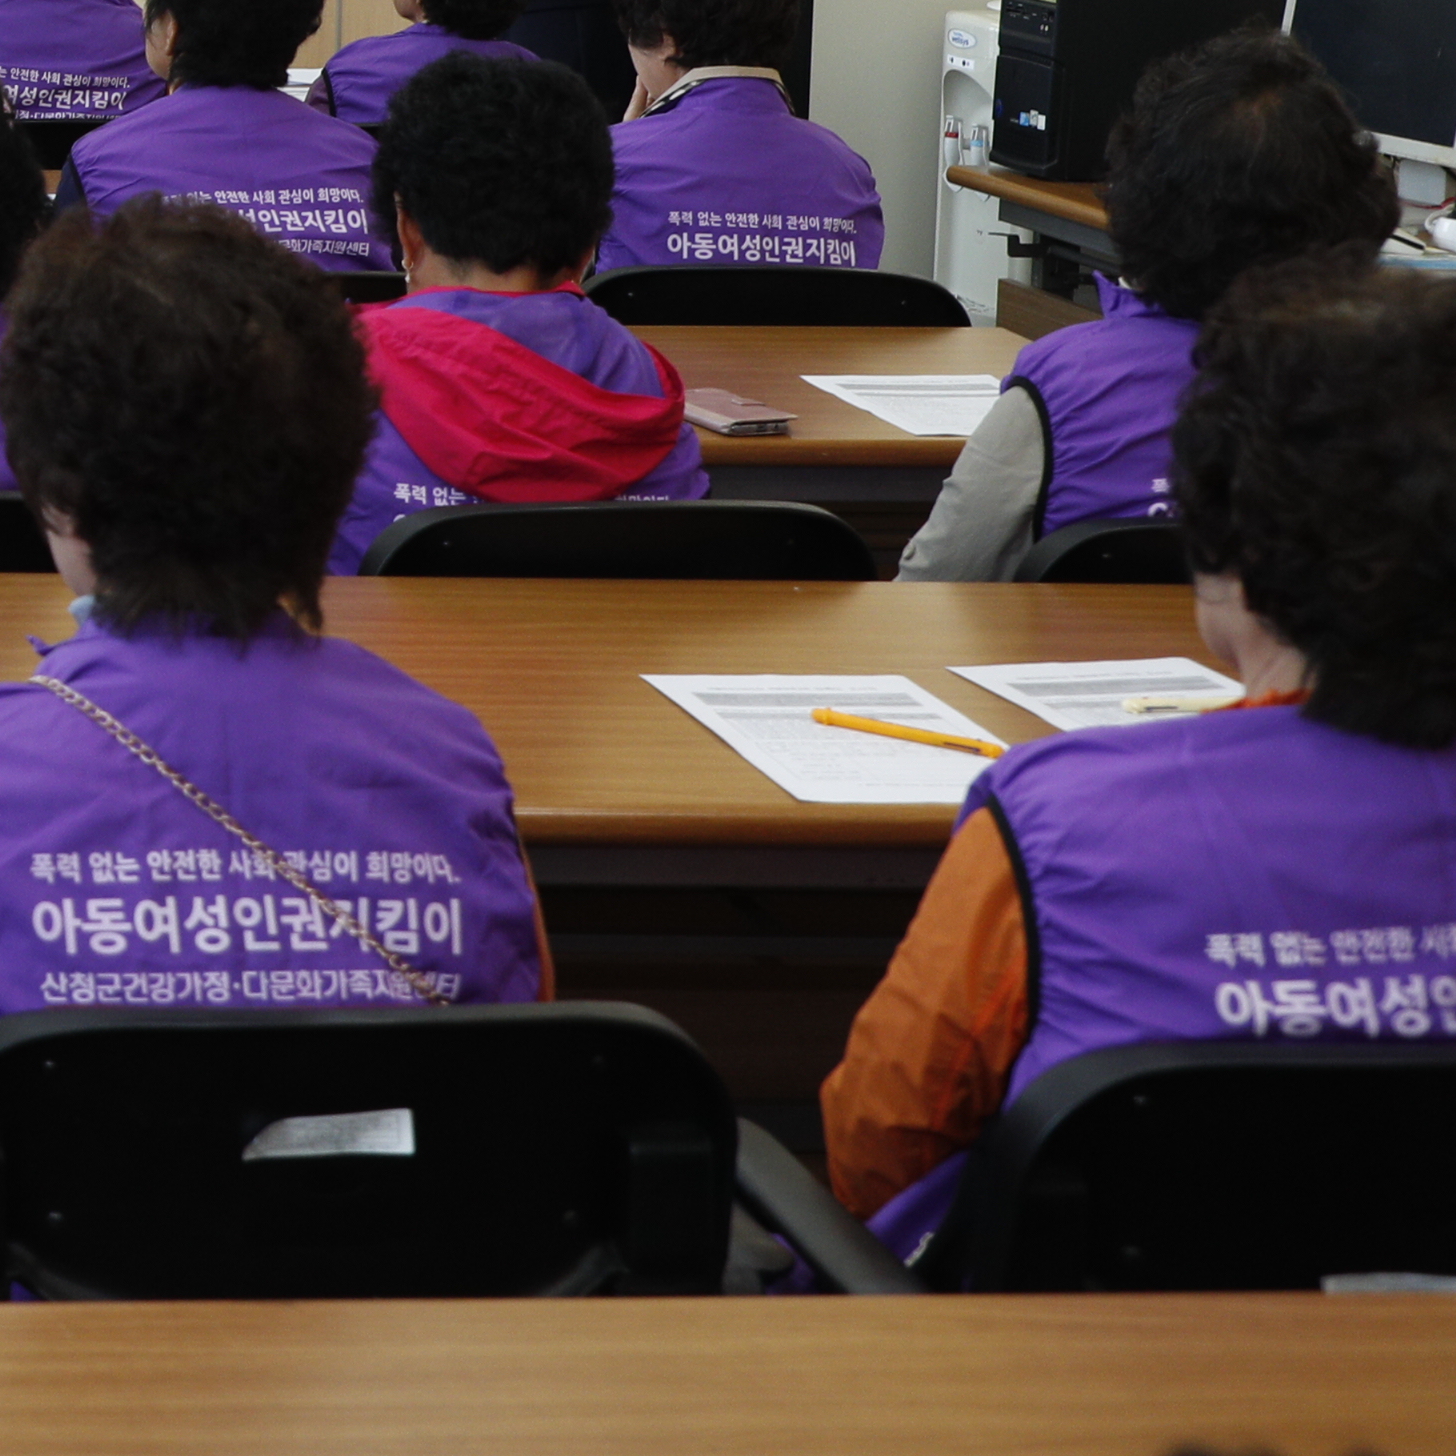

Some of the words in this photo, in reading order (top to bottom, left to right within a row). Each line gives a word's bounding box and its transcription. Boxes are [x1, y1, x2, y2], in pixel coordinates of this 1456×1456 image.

[10, 67, 40, 82] 안전한
[41, 71, 61, 85] 사회
[214, 190, 250, 204] 안전한
[252, 190, 276, 205] 사회
[278, 189, 314, 204] 관심이
[317, 187, 364, 204] 희망이다.
[668, 210, 693, 226] 폭력
[697, 211, 722, 227] 없는
[725, 212, 760, 229] 안전한
[762, 213, 783, 230] 사회
[786, 214, 821, 231] 관심이
[667, 232, 856, 267] 아동여성인권지킴이
[393, 482, 427, 505] 폭력
[432, 487, 467, 507] 없는
[30, 851, 82, 883] 폭력
[88, 851, 141, 883] 없는
[146, 849, 222, 882] 안전한
[365, 850, 462, 884] 희망이다.
